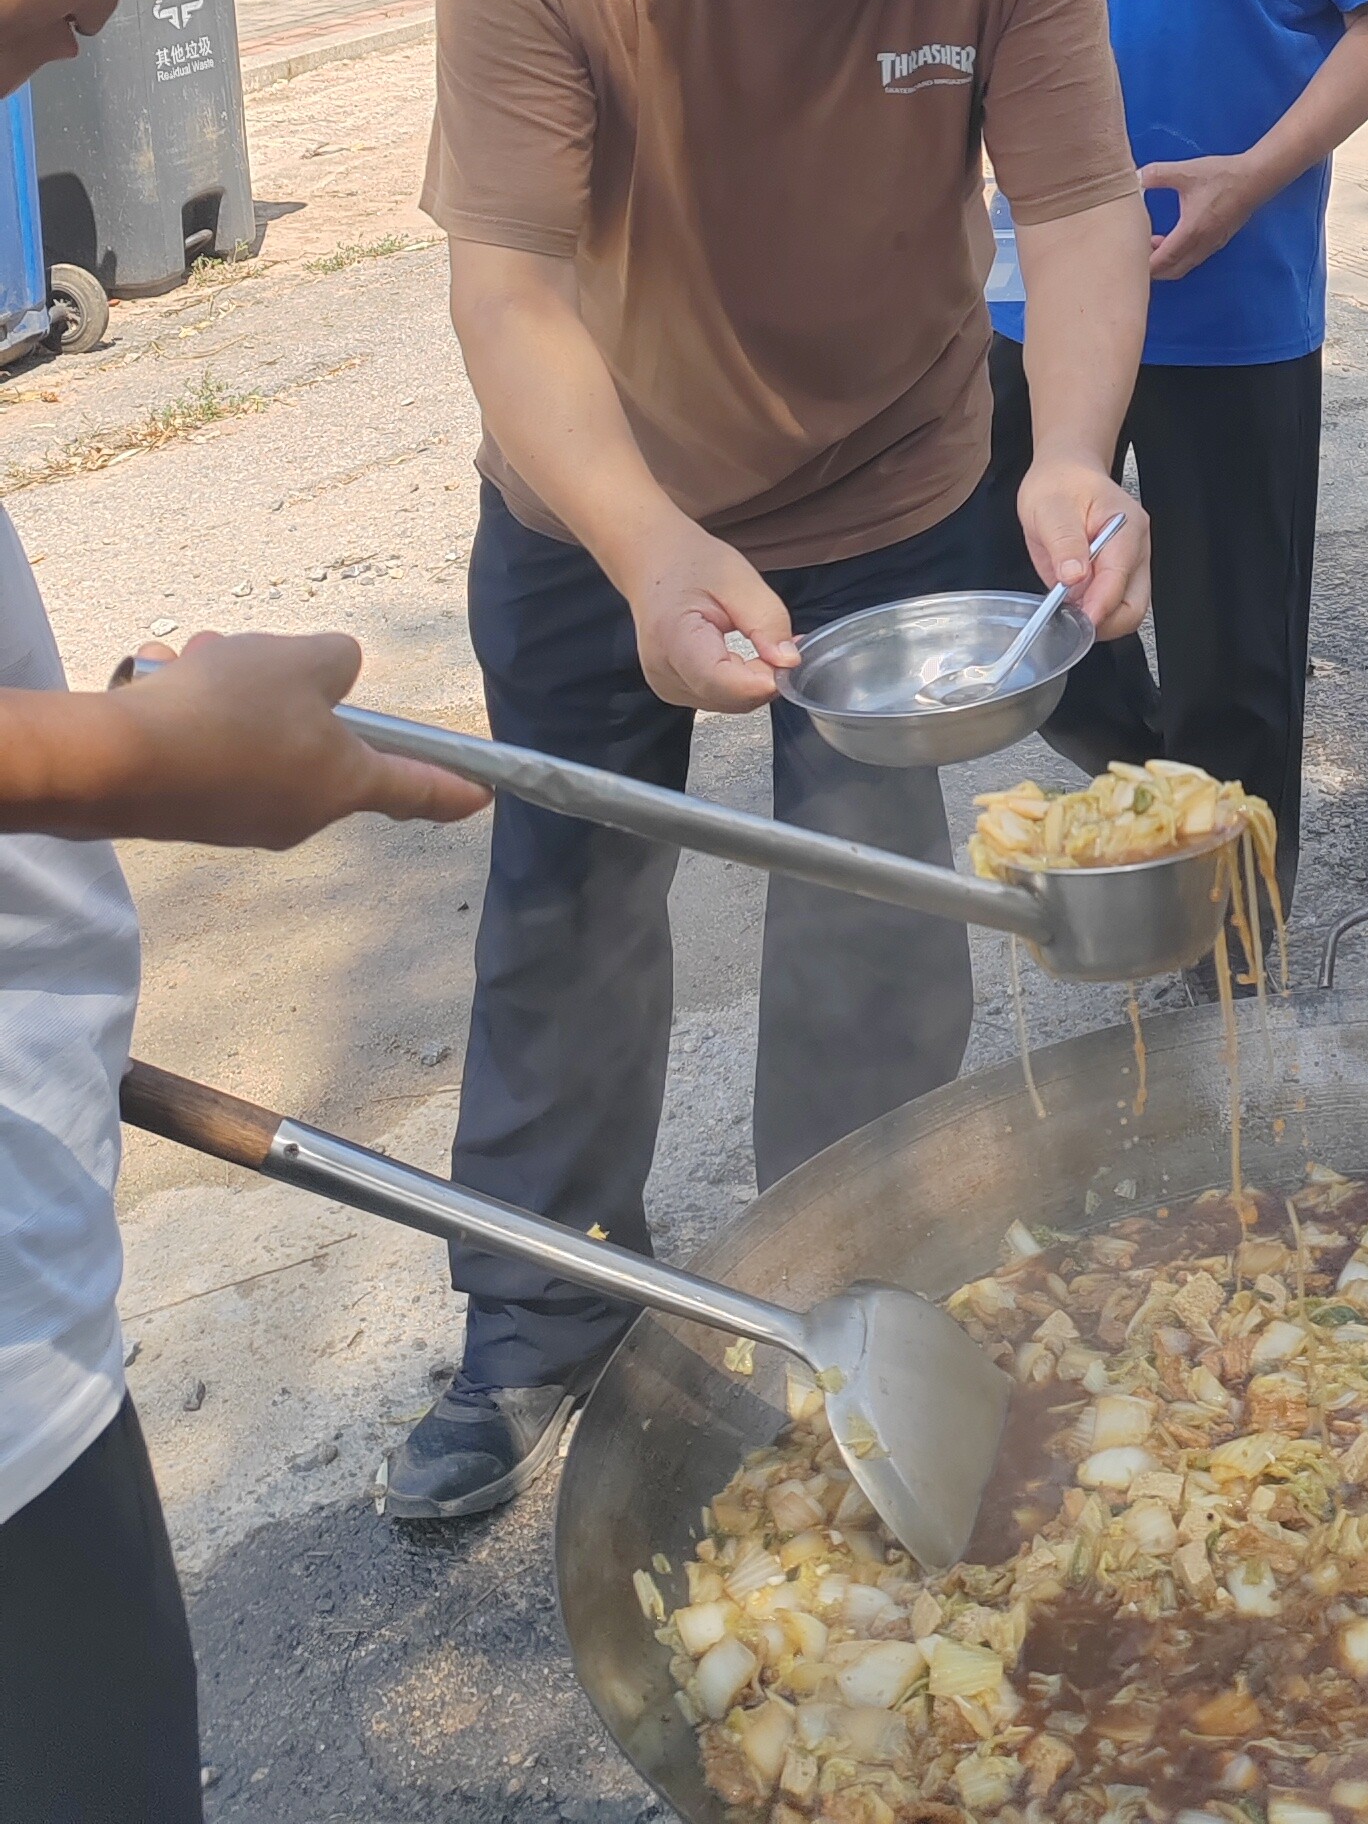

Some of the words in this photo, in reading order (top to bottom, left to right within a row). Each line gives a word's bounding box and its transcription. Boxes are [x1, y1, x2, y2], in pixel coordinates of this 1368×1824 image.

[155, 36, 213, 70] 其他垃圾
[191, 58, 215, 73] Waste
[876, 43, 976, 87] THRASHER
